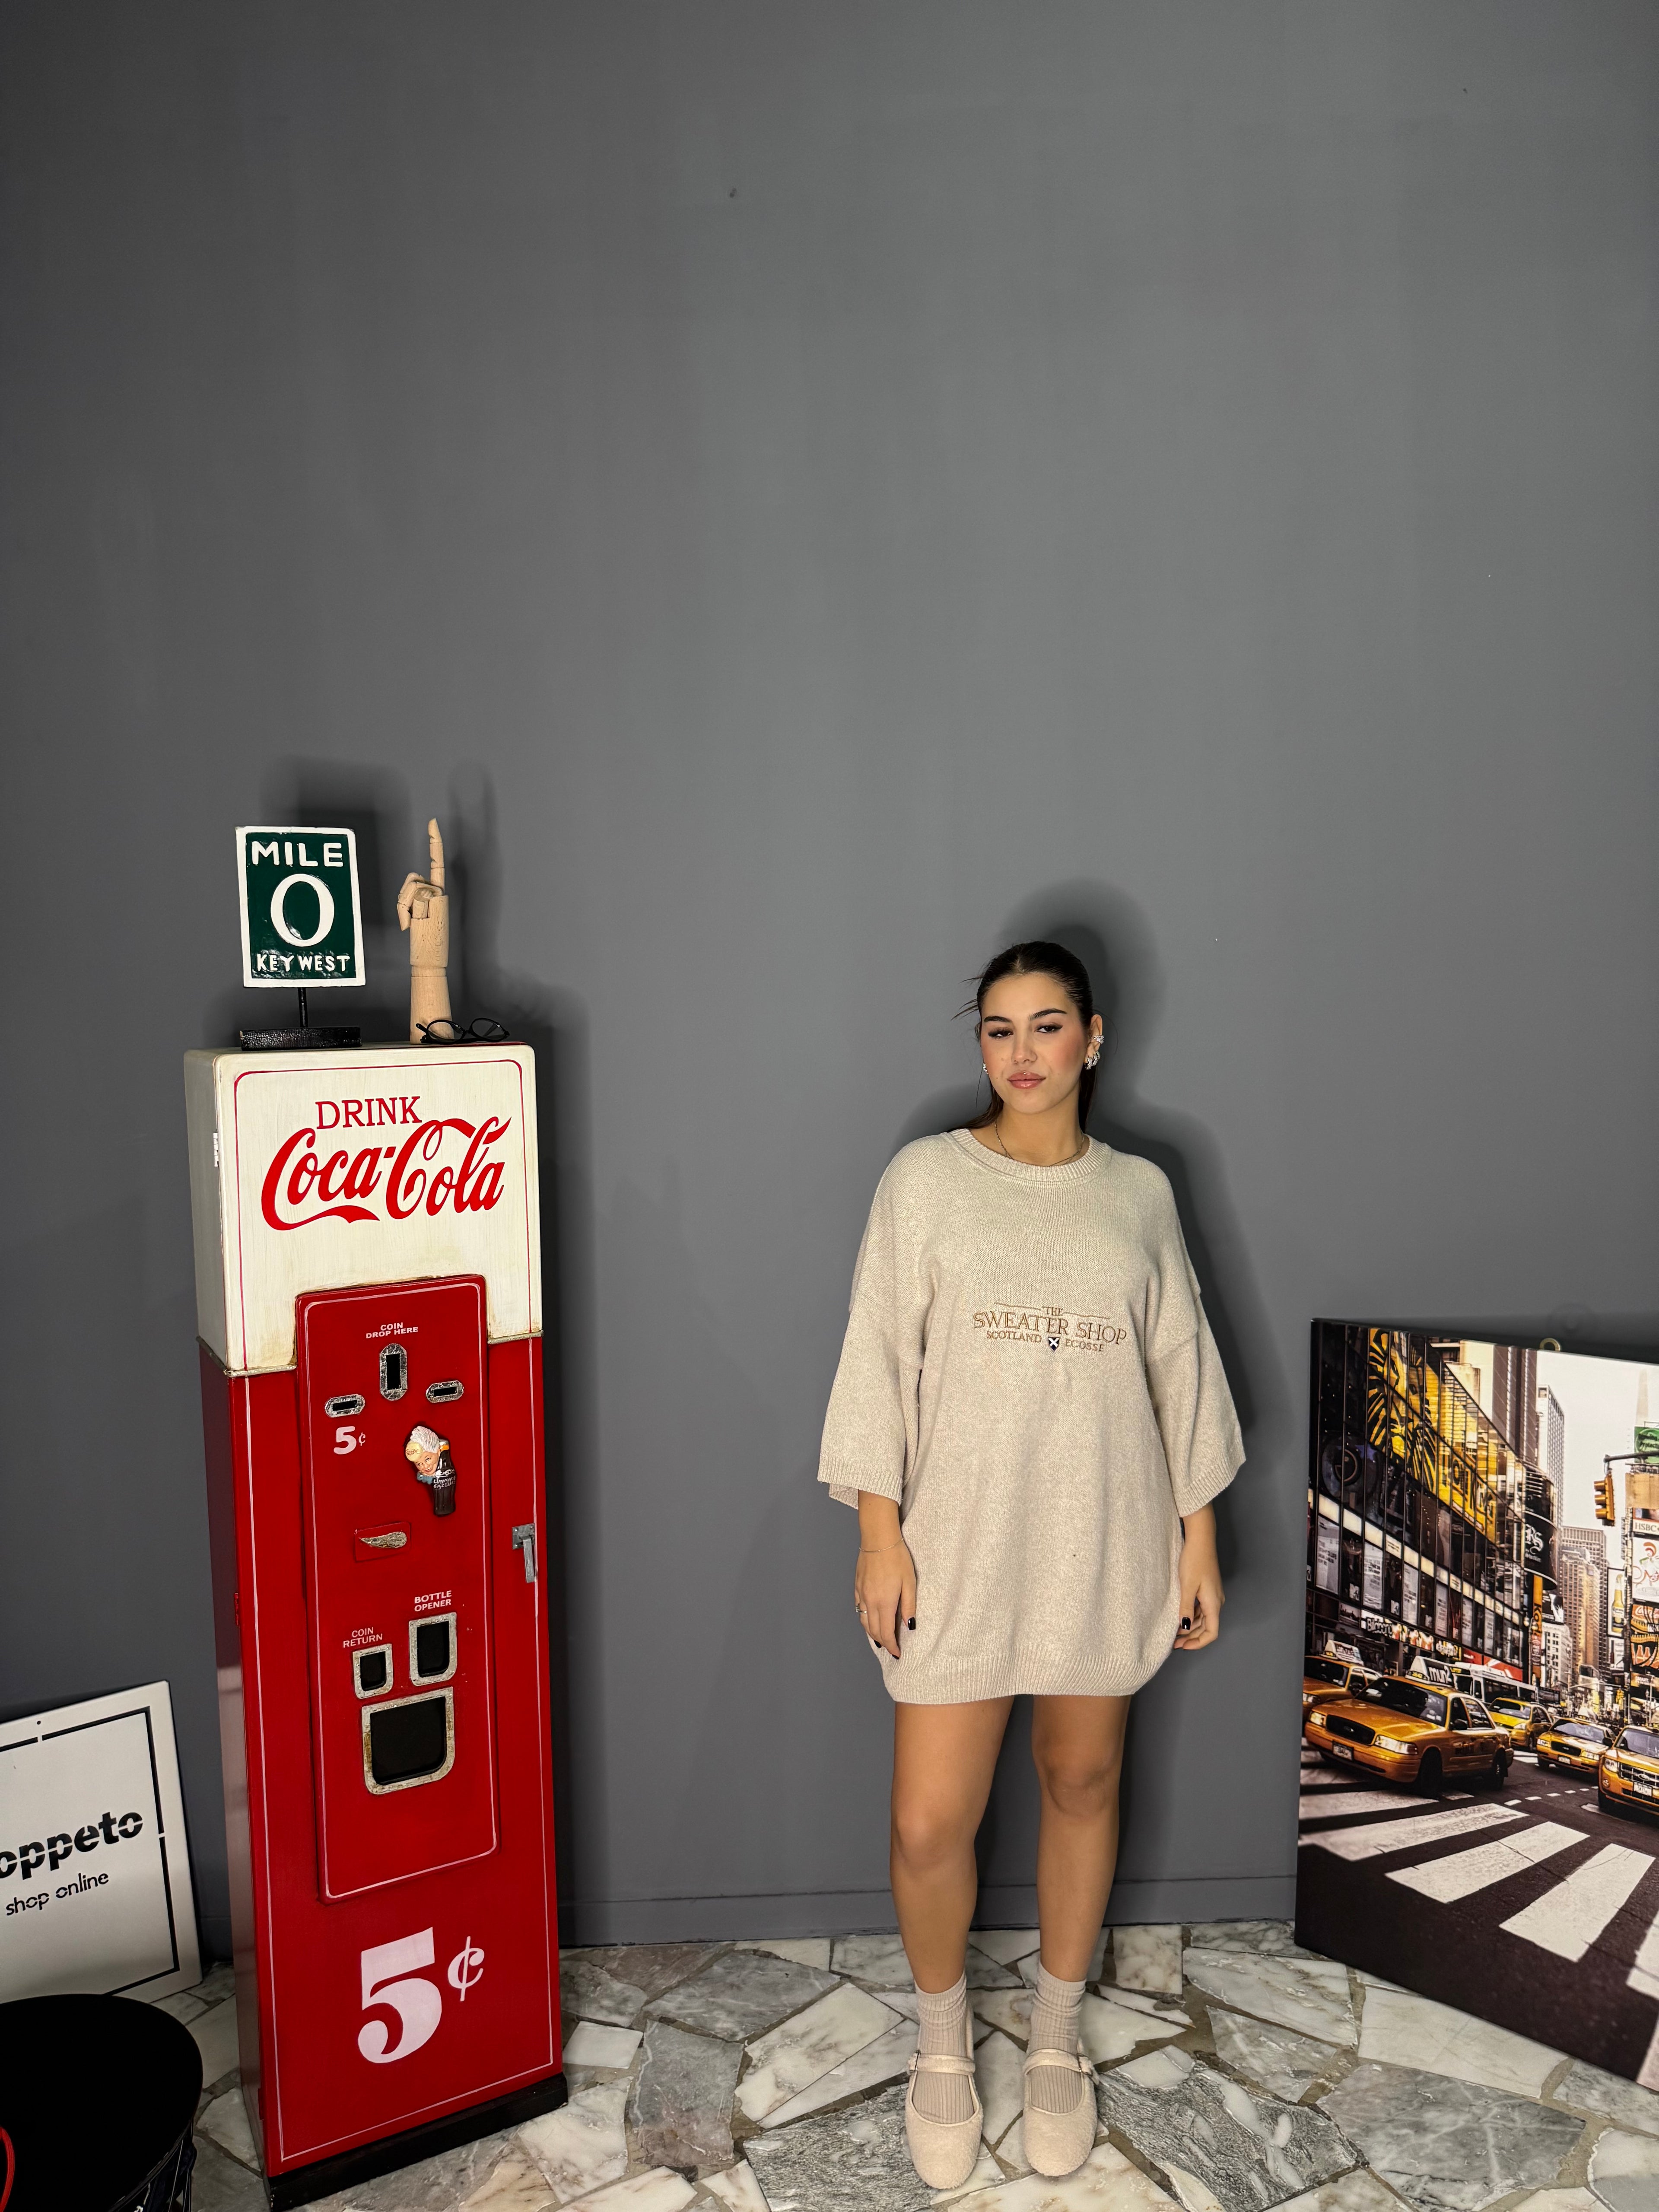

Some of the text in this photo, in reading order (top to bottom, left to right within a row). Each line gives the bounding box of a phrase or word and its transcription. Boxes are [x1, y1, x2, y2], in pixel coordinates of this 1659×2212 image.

[252, 841, 343, 868] MILE
[257, 953, 350, 972] KEY WEST
[315, 1096, 422, 1129] DRINK
[261, 1116, 512, 1231] Coca-Cola
[1042, 1306, 1063, 1316] THE
[365, 1326, 419, 1339] DROP HERE
[380, 1322, 404, 1331] COIN
[973, 1311, 1127, 1345] SWEATER SHOP
[986, 1330, 1104, 1352] SCOTLAND ECOSSE
[1635, 1522, 1657, 1532] HSBC
[414, 1590, 452, 1604] BOTTLE
[414, 1599, 451, 1612] OPENER
[352, 1627, 374, 1638] COIN
[343, 1634, 383, 1648] RETURN
[6, 1872, 109, 1916] shop online
